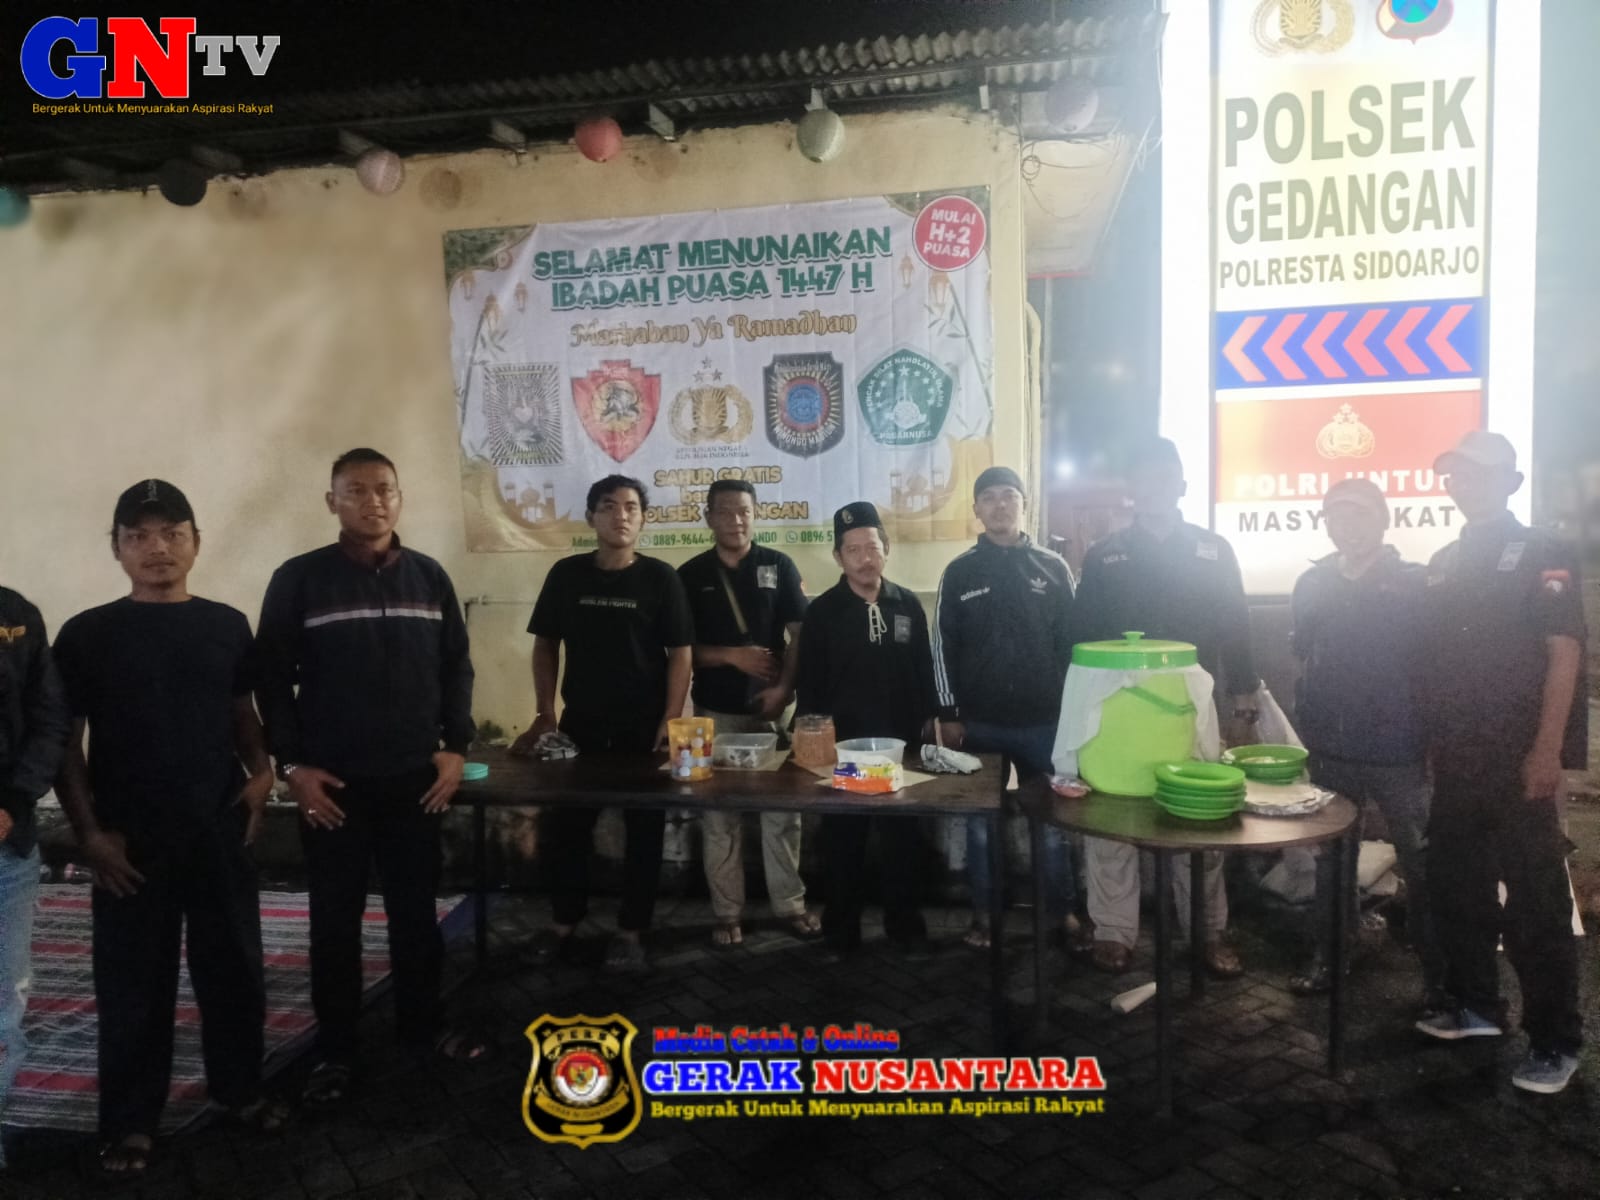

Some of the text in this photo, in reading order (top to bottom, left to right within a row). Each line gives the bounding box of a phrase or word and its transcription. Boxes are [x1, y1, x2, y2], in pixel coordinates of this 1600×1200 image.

[1224, 76, 1476, 168] POLSEK
[930, 208, 977, 225] MULAI
[1225, 165, 1476, 246] GEDANGAN
[929, 221, 971, 245] H+2
[532, 226, 893, 280] SELAMAT MENUNAIKAN
[922, 241, 971, 259] PUASA
[1219, 245, 1480, 289] POLRESTA SIDOARJO
[551, 261, 875, 311] IBADAH PUASA 1447 H
[691, 315, 724, 348] Ya
[727, 309, 857, 342] Ramadhan
[654, 465, 783, 487] SAHUR GRATIS
[1233, 469, 1451, 497] POLRI NTU
[643, 504, 702, 523] OLSEK
[1238, 505, 1456, 532] MASYKAT
